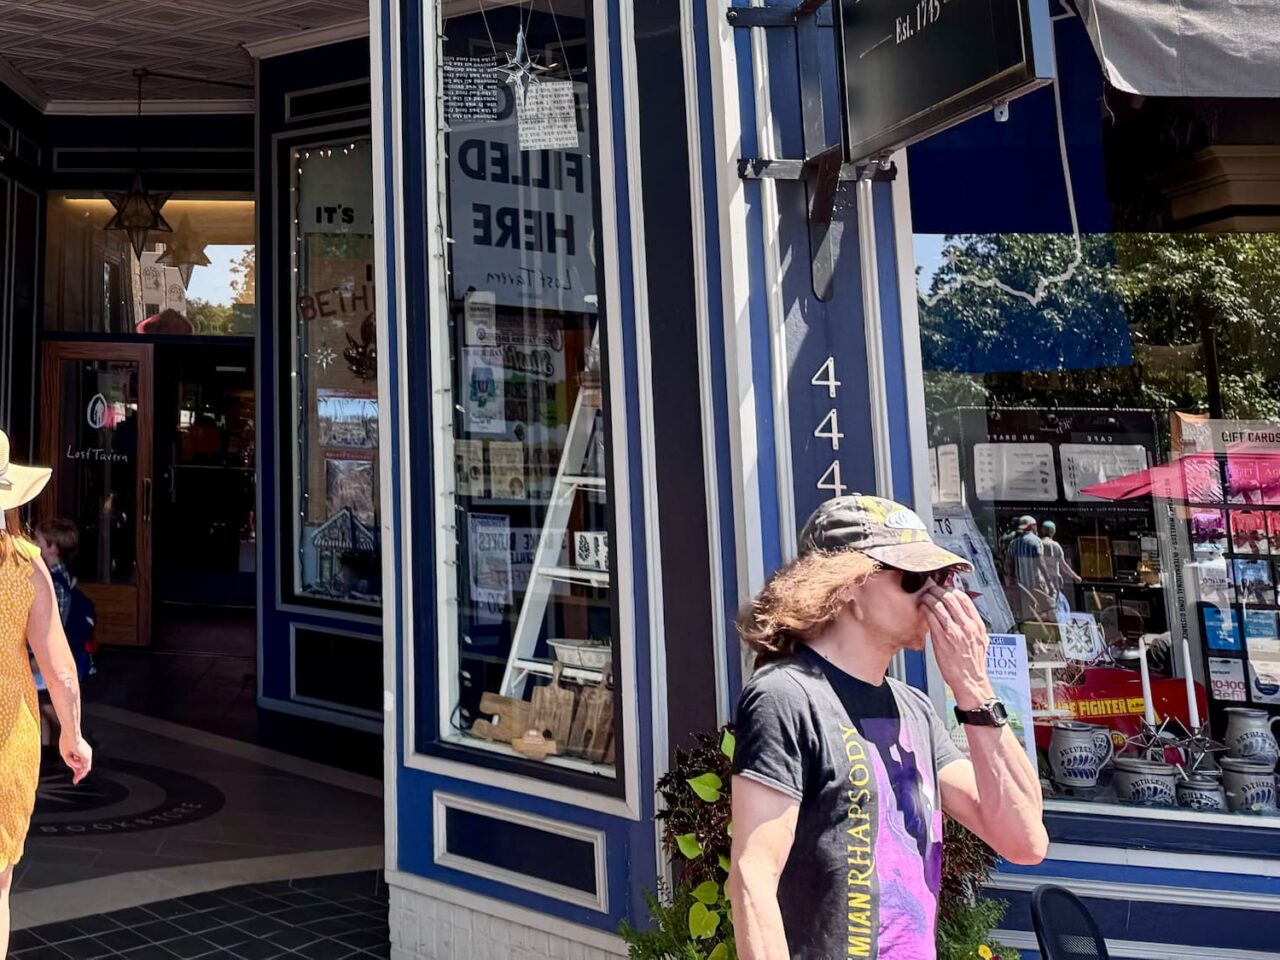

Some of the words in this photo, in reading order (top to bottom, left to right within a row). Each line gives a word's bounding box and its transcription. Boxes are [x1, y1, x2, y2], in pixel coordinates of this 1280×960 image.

[895, 16, 914, 44] Est.
[315, 204, 355, 224] IT'S
[1221, 431, 1246, 442] GIFT
[1078, 698, 1127, 717] FIGHTER
[838, 722, 876, 887] RHAPSODY
